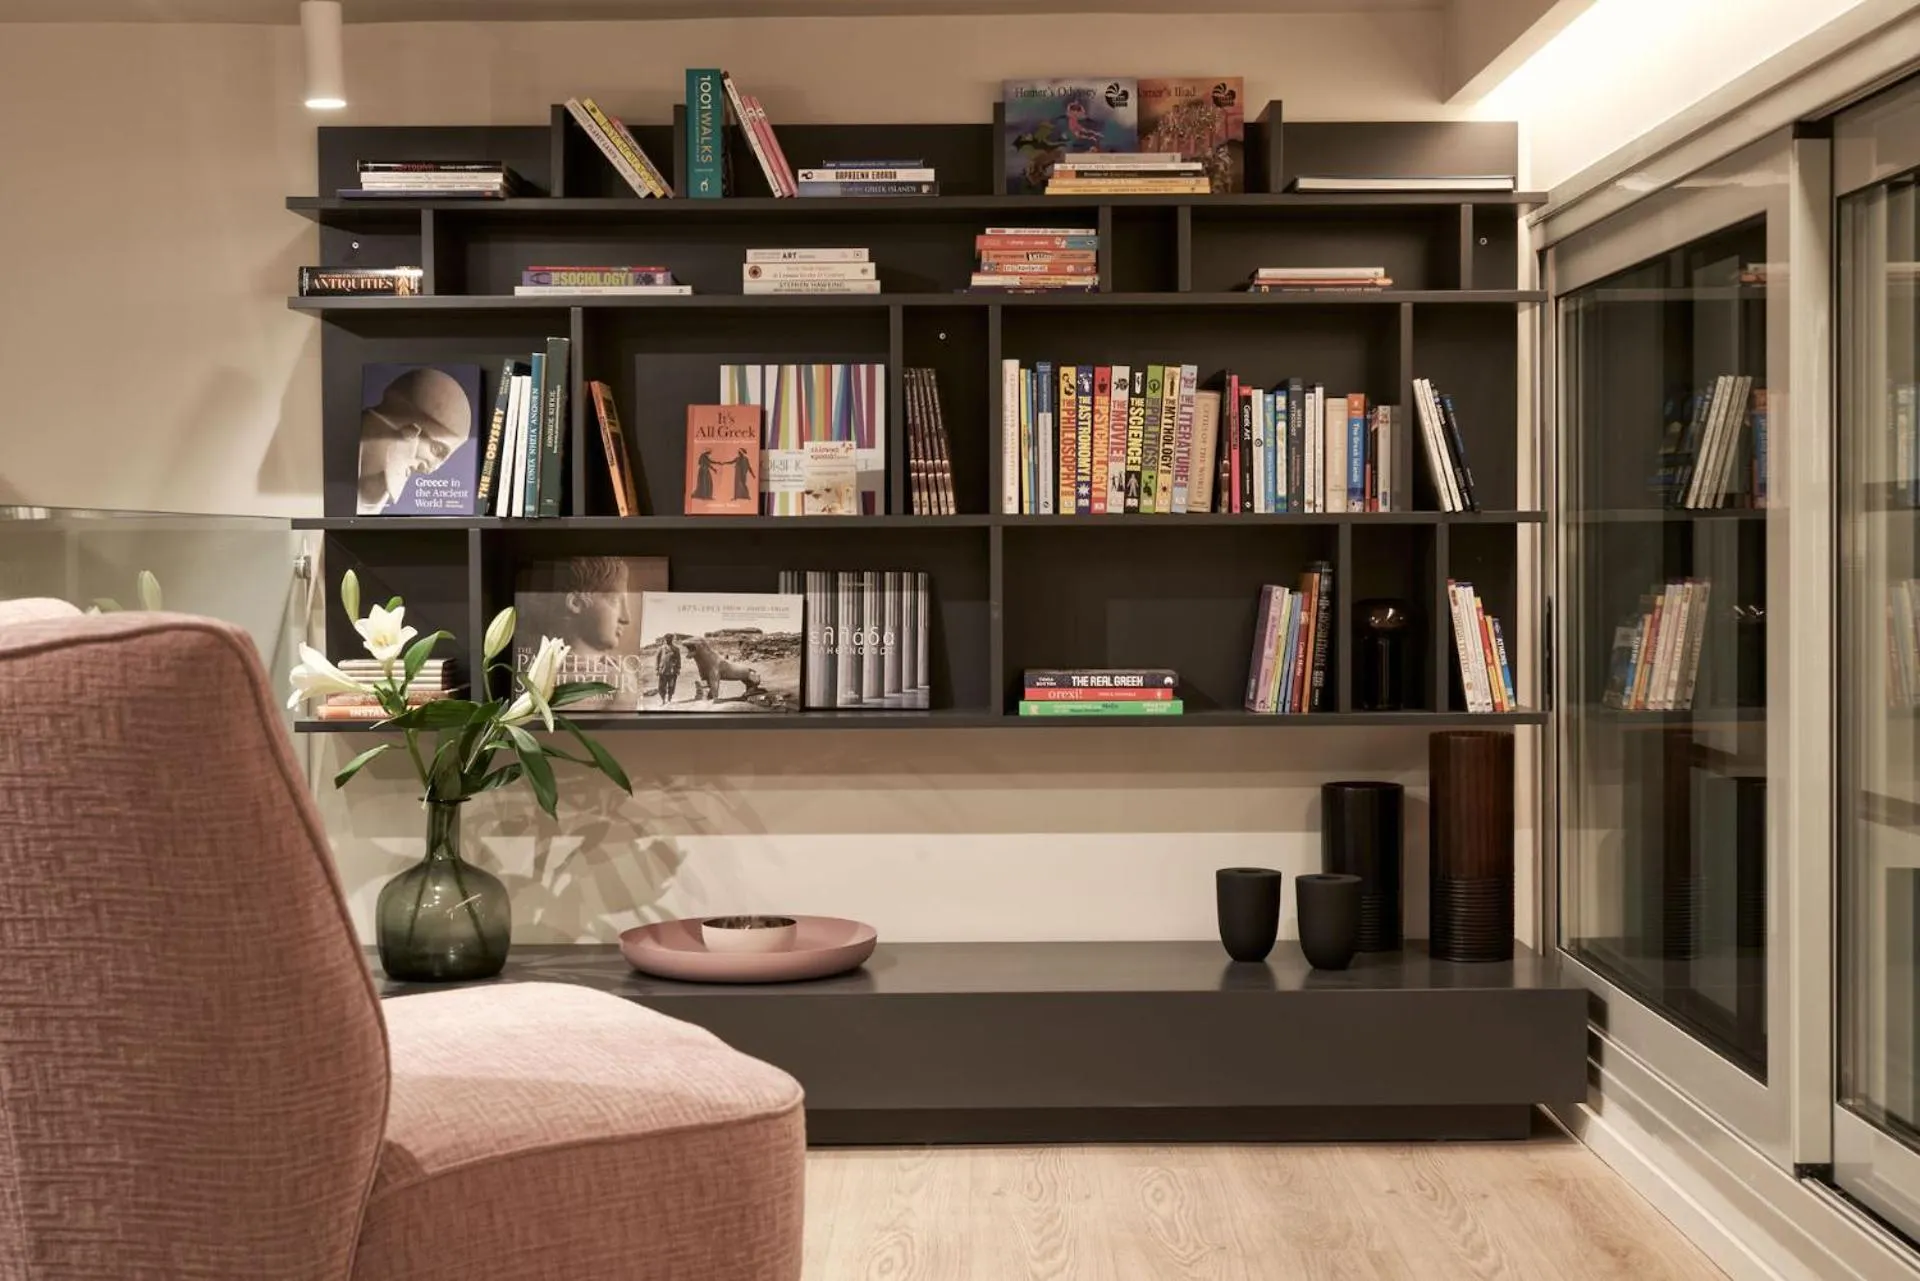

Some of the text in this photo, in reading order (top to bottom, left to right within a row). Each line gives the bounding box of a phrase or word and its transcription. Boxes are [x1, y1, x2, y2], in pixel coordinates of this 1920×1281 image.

[1014, 85, 1097, 100] Homer's Odyssey
[1174, 85, 1197, 97] Iliad
[700, 75, 713, 163] 1001 WALKS
[314, 278, 394, 292] ANTIQUITIES
[560, 271, 626, 285] SOCIOLOGY
[718, 412, 735, 425] It's
[1243, 404, 1251, 441] Greek Art
[1352, 423, 1360, 436] The
[696, 425, 756, 438] All Greek
[1077, 405, 1092, 474] ASTRONOMY
[1111, 410, 1126, 455] MOVIE
[1127, 406, 1144, 464] SCIENCE
[1144, 407, 1160, 465] POLITICS
[1161, 405, 1176, 469] MYTHOLOGY
[1174, 403, 1194, 480] LITERATURE
[478, 476, 491, 500] THE
[485, 407, 505, 460] ODYSSEY
[1061, 408, 1076, 489] PHILOSOPHY
[1092, 406, 1108, 491] PSYCHOLOGY
[1197, 403, 1209, 498] CITIES OF THE WORLD
[1351, 458, 1360, 483] Islands
[415, 477, 461, 487] Greece in
[415, 488, 469, 498] the Ancient
[415, 498, 443, 508] World
[808, 626, 895, 646] ελλάδα
[1496, 638, 1507, 666] ATHENS
[517, 654, 641, 673] PTHENO
[1071, 675, 1144, 687] THE REAL GREEK
[1048, 689, 1083, 700] orexi!
